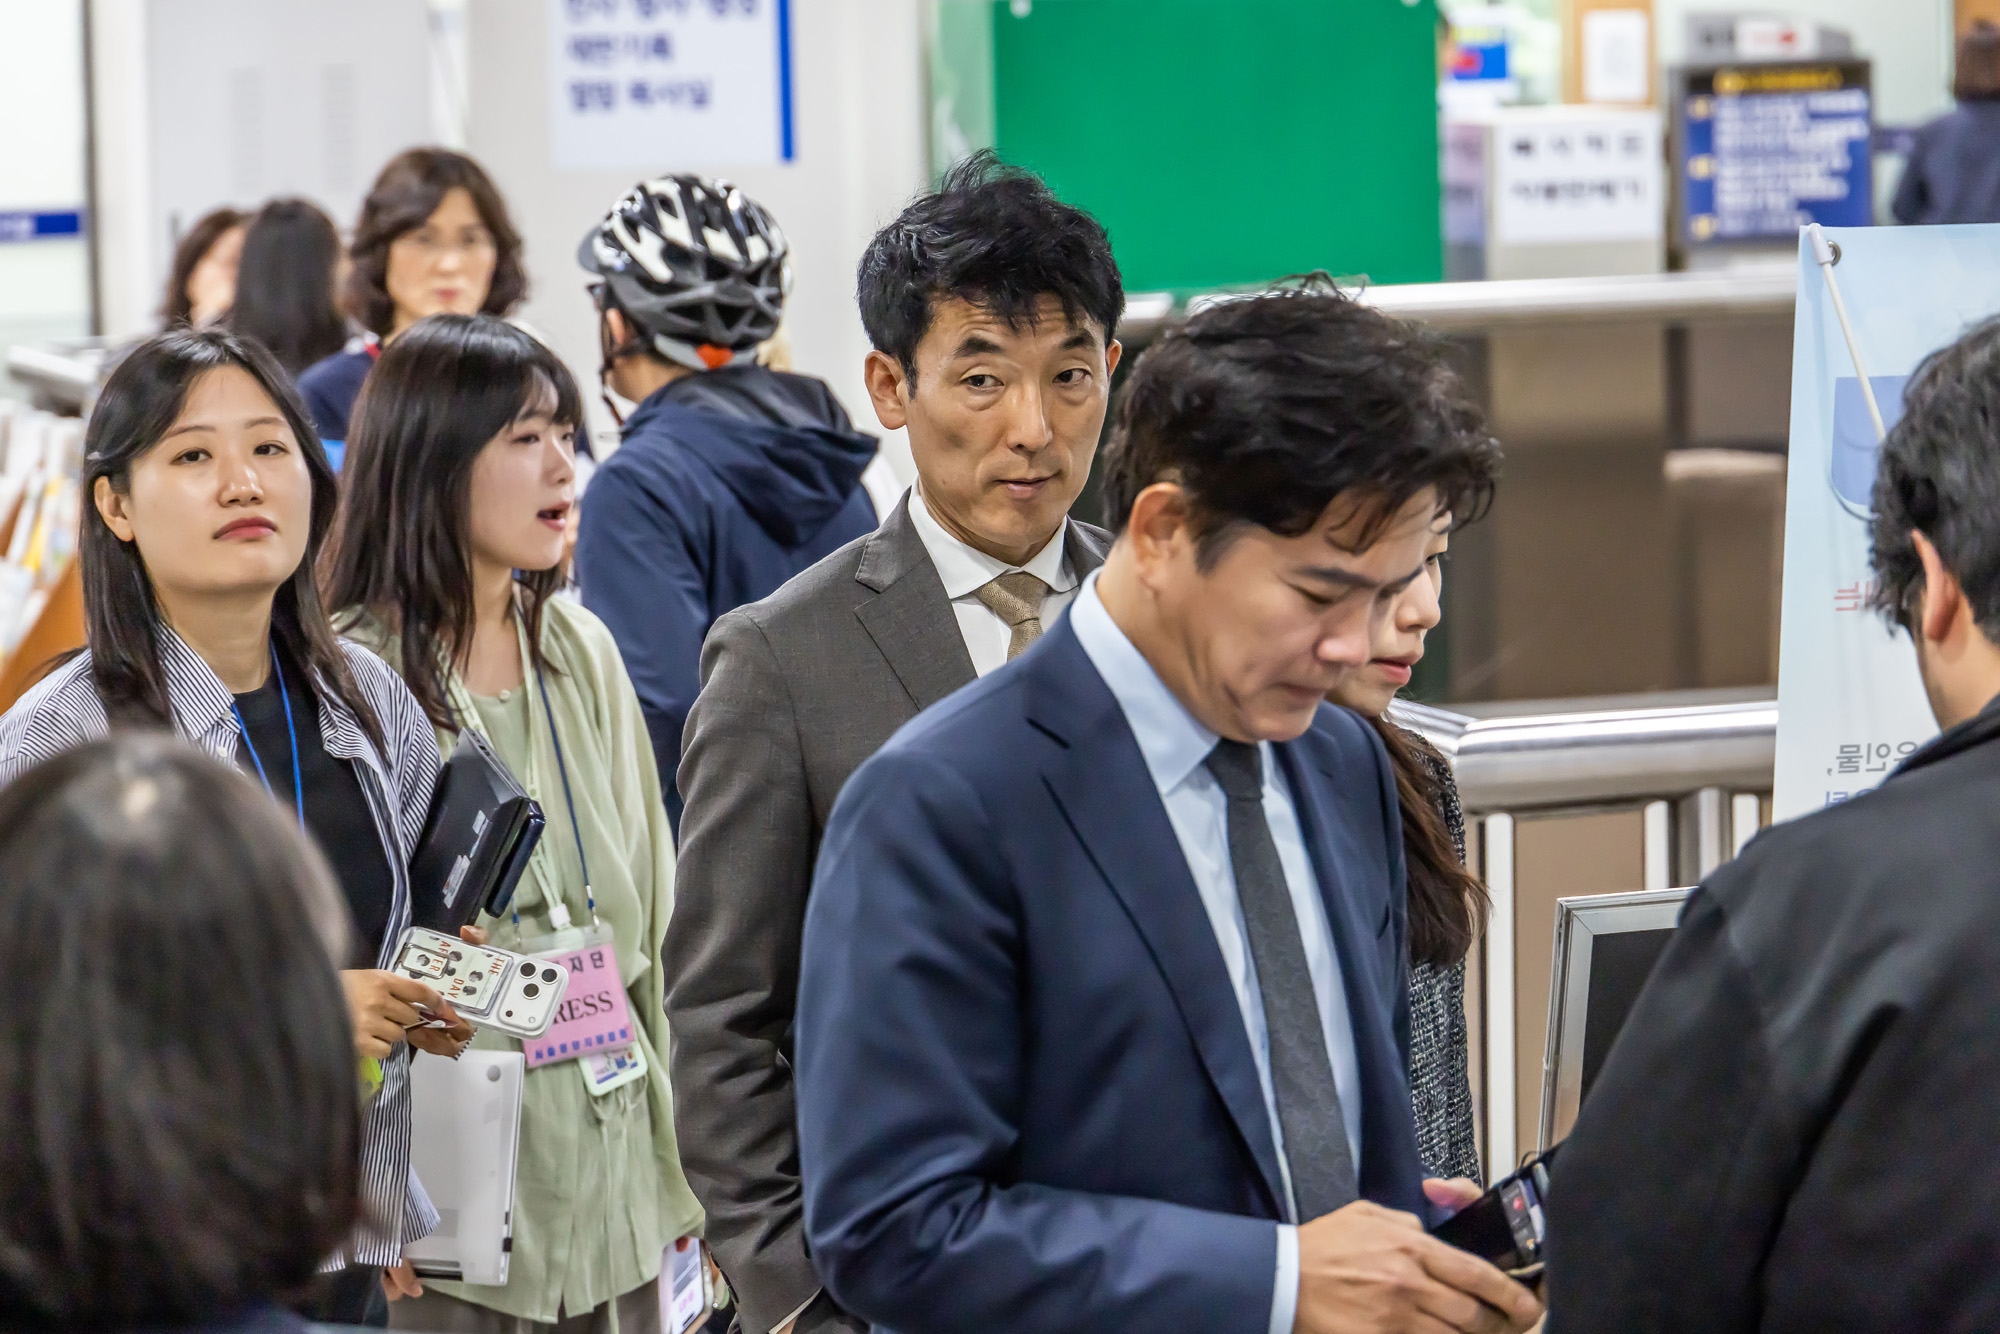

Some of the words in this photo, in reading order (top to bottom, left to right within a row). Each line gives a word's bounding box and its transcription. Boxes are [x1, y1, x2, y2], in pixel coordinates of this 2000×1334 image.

[488, 957, 505, 977] THE
[447, 978, 465, 999] DAY
[553, 990, 613, 1025] RESS
